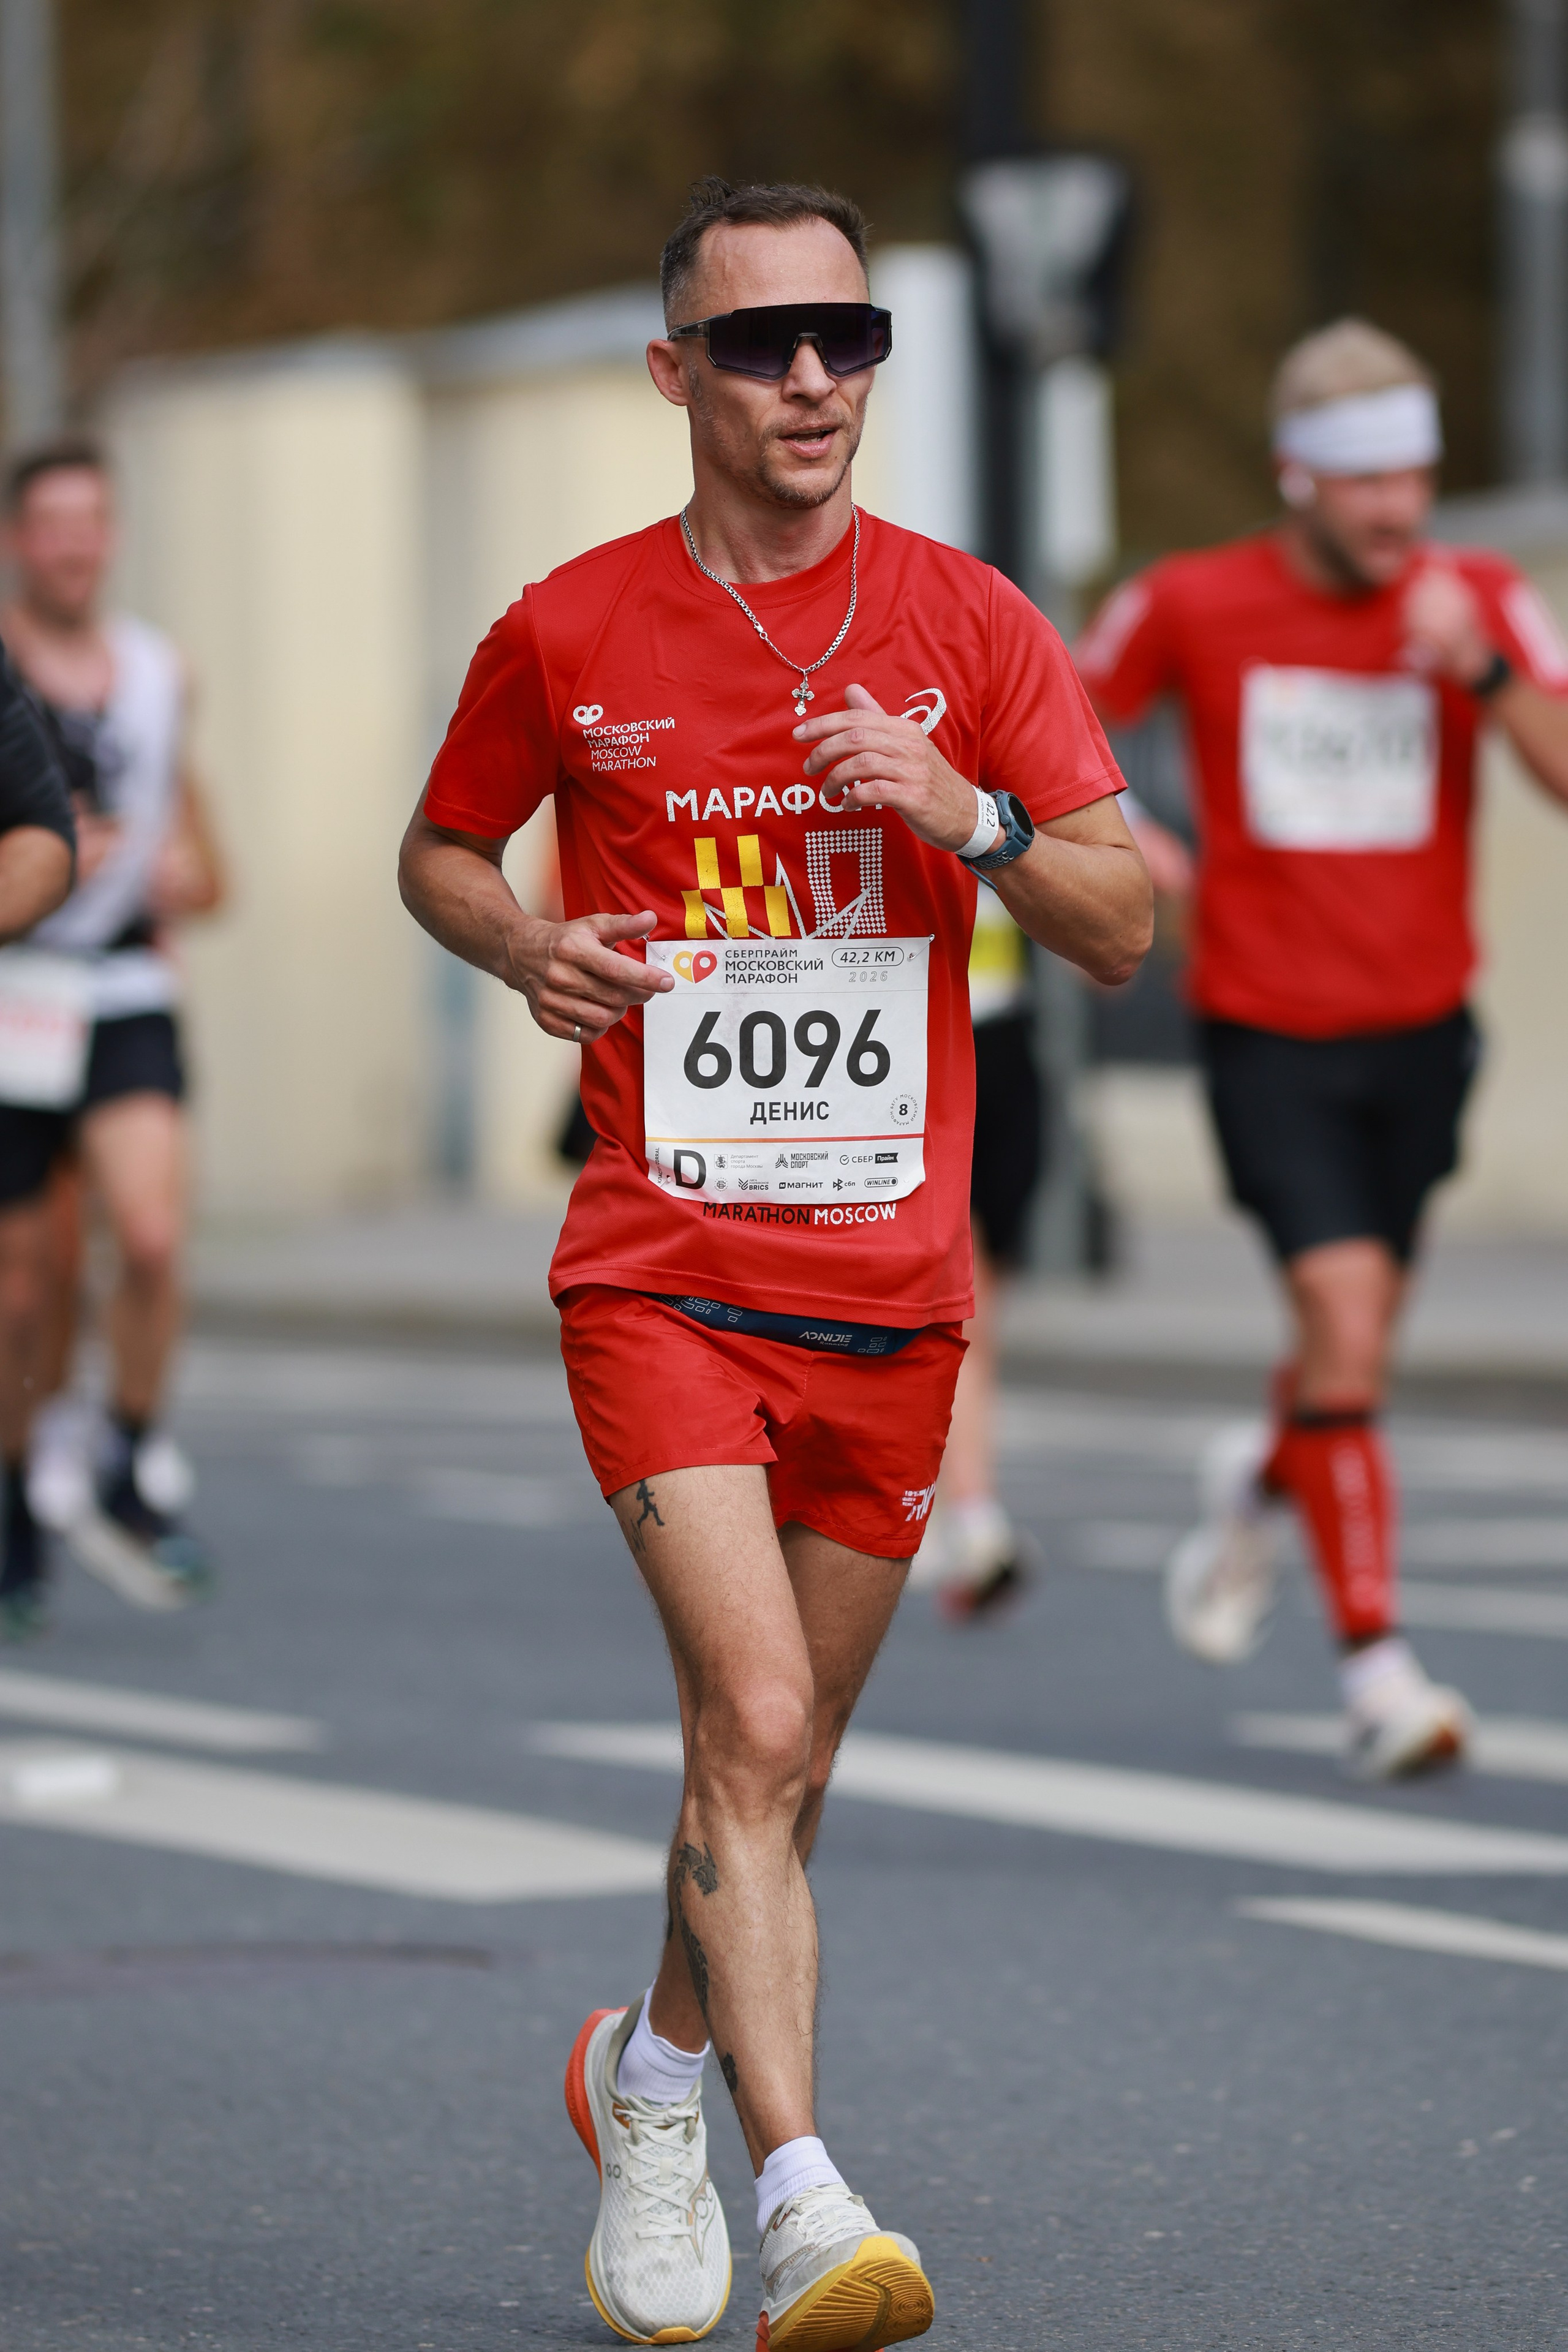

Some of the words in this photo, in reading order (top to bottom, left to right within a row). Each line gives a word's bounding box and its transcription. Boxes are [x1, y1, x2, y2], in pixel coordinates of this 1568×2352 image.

[582, 717, 675, 739] МОСКОВСКИЙ
[587, 733, 649, 748] МАРАФОН
[591, 745, 642, 760] MOSCOW
[592, 756, 657, 772] MARATHON
[665, 776, 882, 822] МАРАФО
[986, 801, 995, 827] 42,2
[725, 948, 797, 958] СБЕРПРАЙМ
[840, 951, 869, 964] 42,2
[725, 958, 823, 971] МОСКОВСКИЙ
[725, 973, 797, 984] МАРАФОН
[848, 971, 888, 982] 2026
[684, 1009, 891, 1089] 6096
[750, 1101, 829, 1125] ДЕНИС
[899, 1104, 908, 1116] 8
[791, 1151, 829, 1161] МОСКОВСКИЙ
[673, 1149, 706, 1189] D
[704, 1201, 810, 1224] MARATHON
[814, 1203, 897, 1225] MOSCOW
